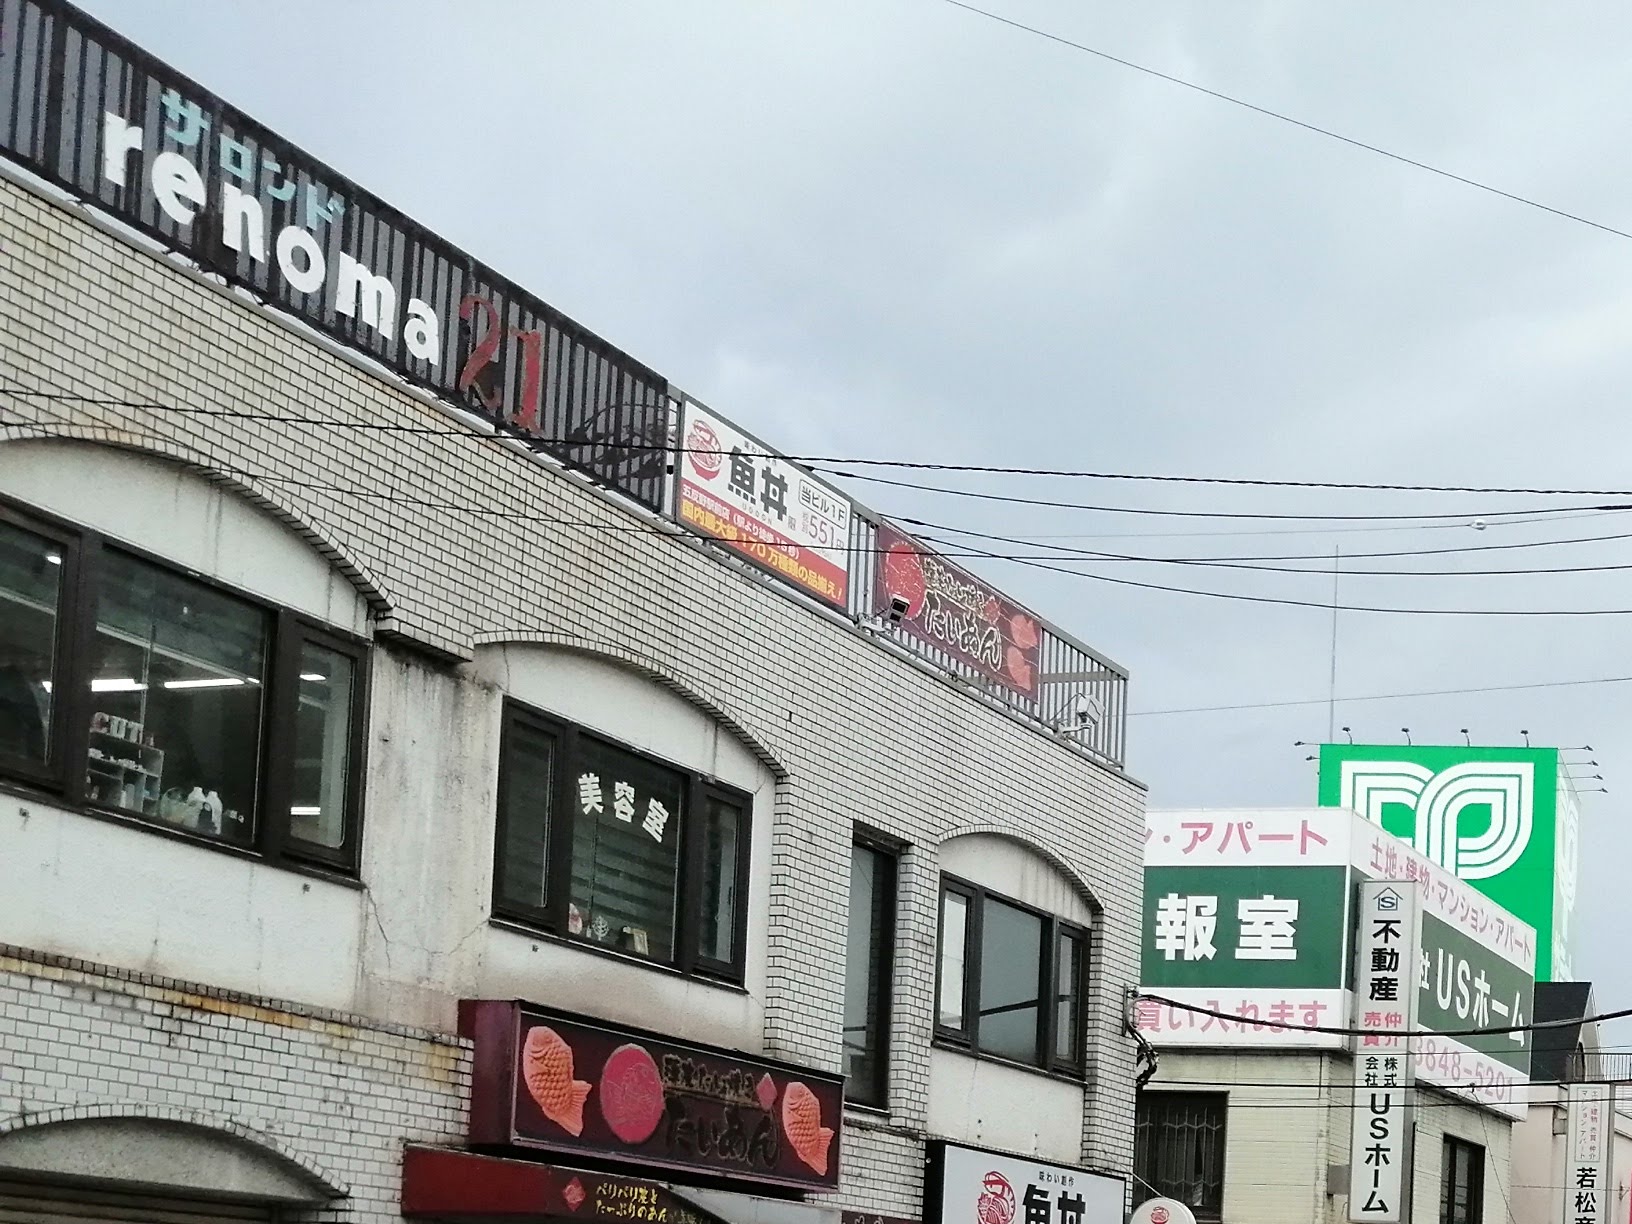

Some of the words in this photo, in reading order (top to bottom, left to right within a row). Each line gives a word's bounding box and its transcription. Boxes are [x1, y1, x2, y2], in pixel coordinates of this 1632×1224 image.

[161, 88, 346, 230] サロンド
[104, 111, 440, 365] renoma
[458, 293, 545, 435] 21
[577, 772, 670, 844] 美容室
[1369, 919, 1402, 1002] 不動産
[1436, 947, 1525, 1048] USホーム
[1361, 1093, 1391, 1214] USホーム
